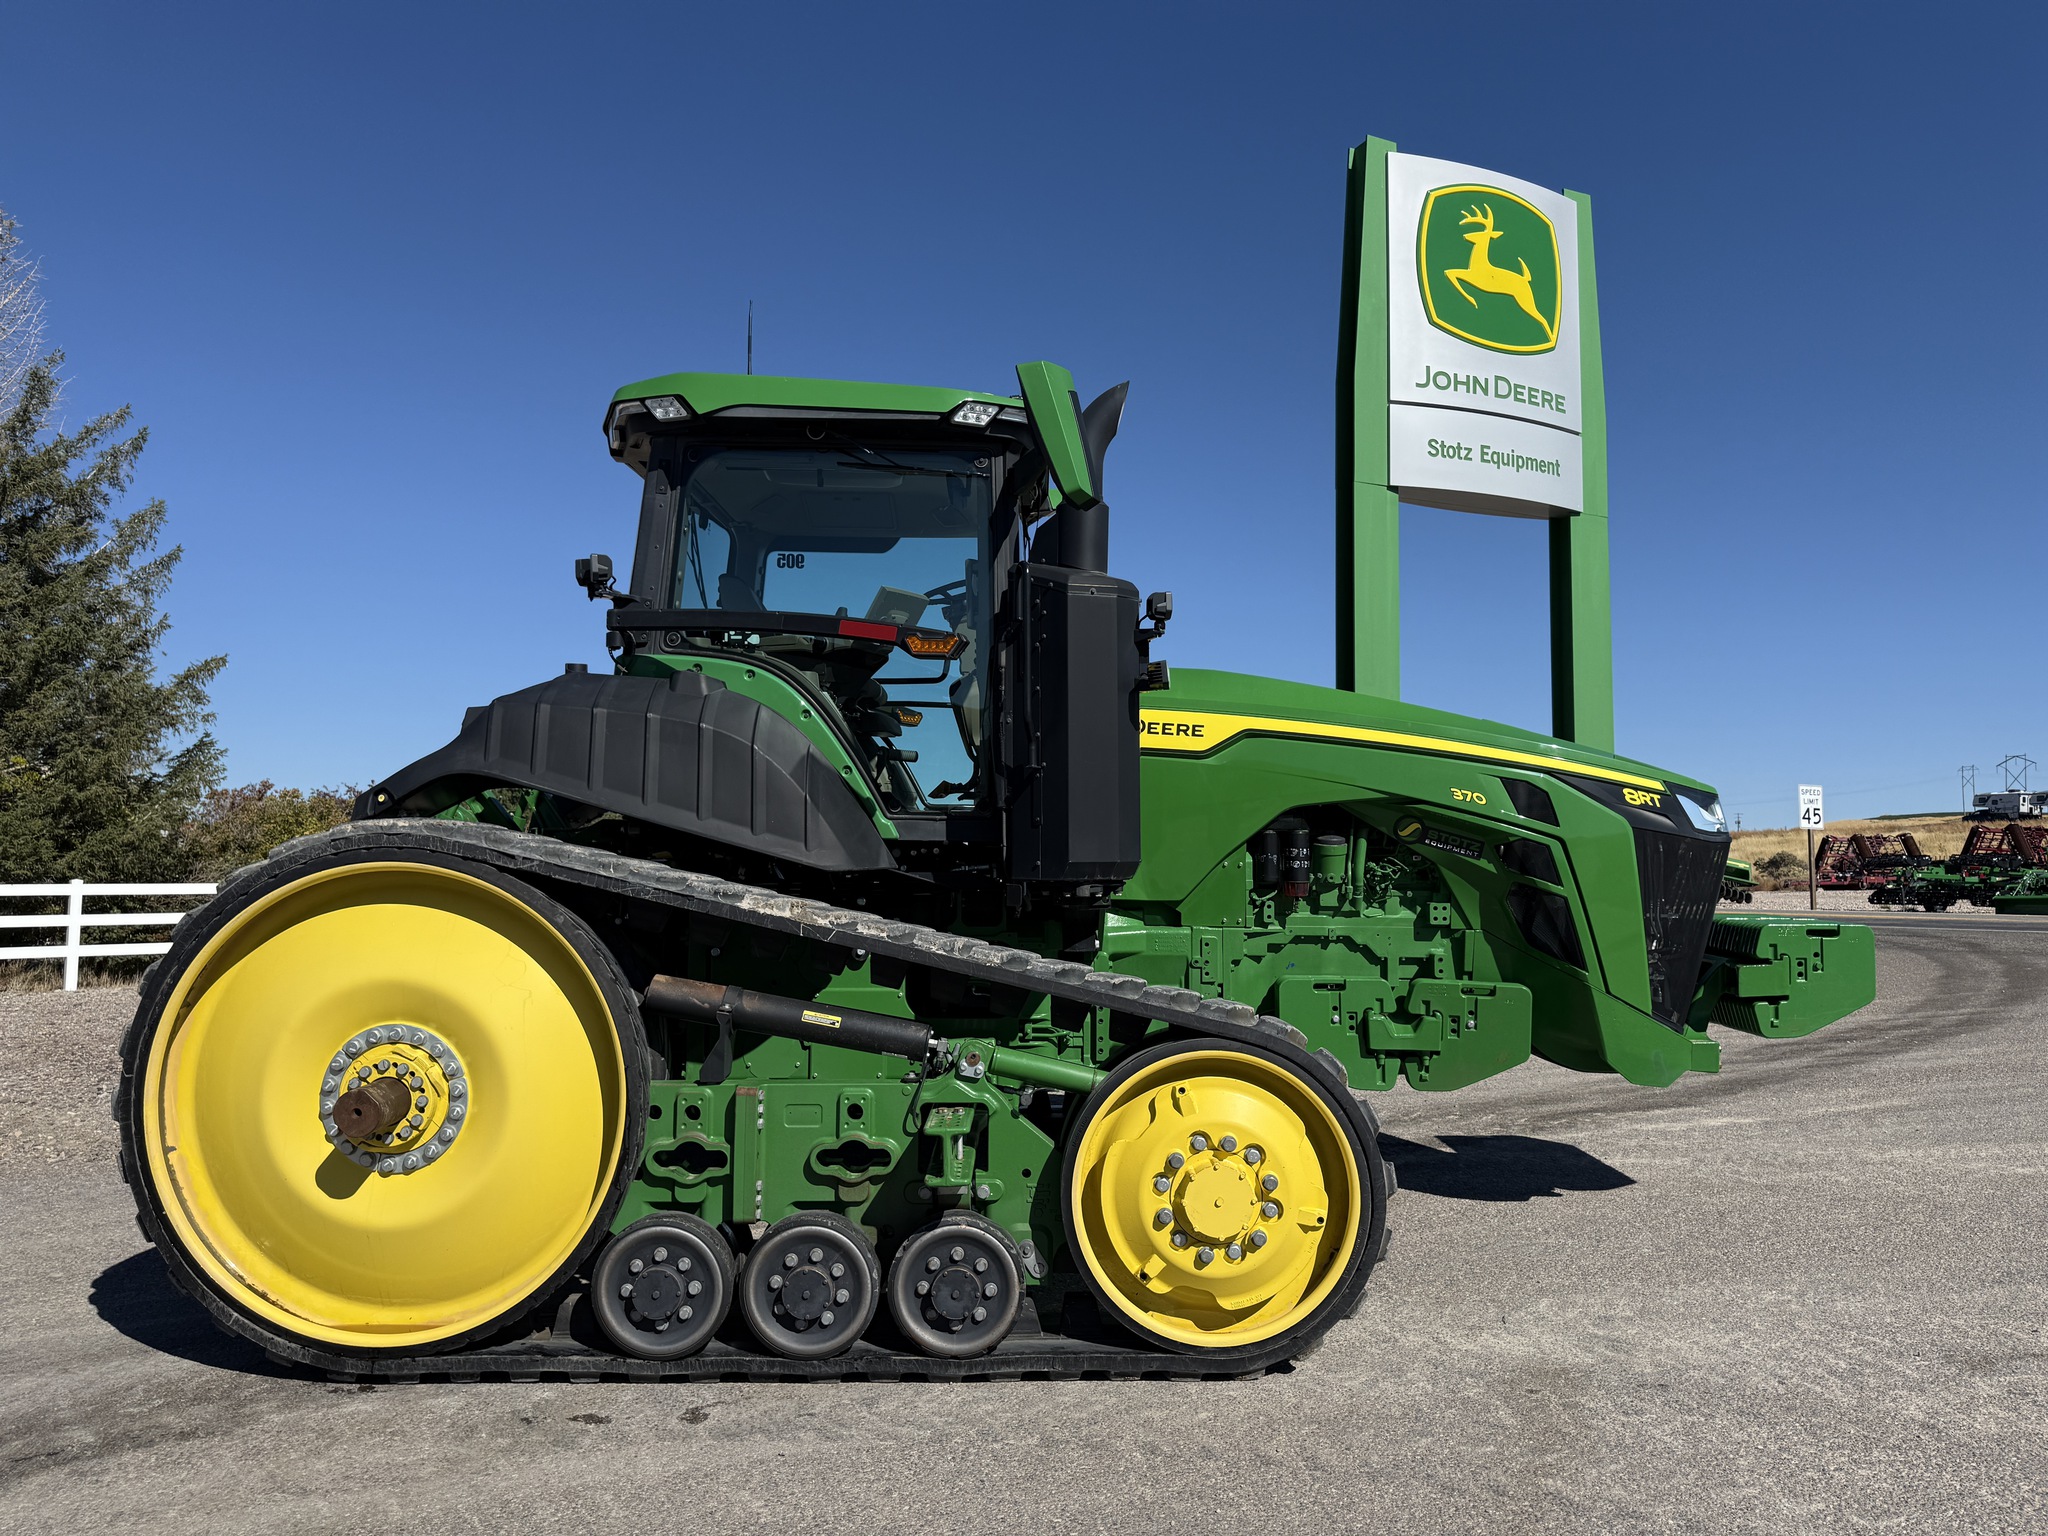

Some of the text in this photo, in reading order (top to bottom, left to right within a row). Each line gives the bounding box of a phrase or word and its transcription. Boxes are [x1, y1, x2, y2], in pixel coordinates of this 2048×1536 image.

[1415, 365, 1567, 414] JOHN DEERE
[1427, 438, 1561, 478] Stotz Equipment
[1450, 787, 1488, 806] 370
[1622, 787, 1661, 808] 8RT
[1802, 807, 1821, 824] 45
[1424, 838, 1479, 857] EQUIPMENT
[1427, 829, 1482, 852] STOTZ
